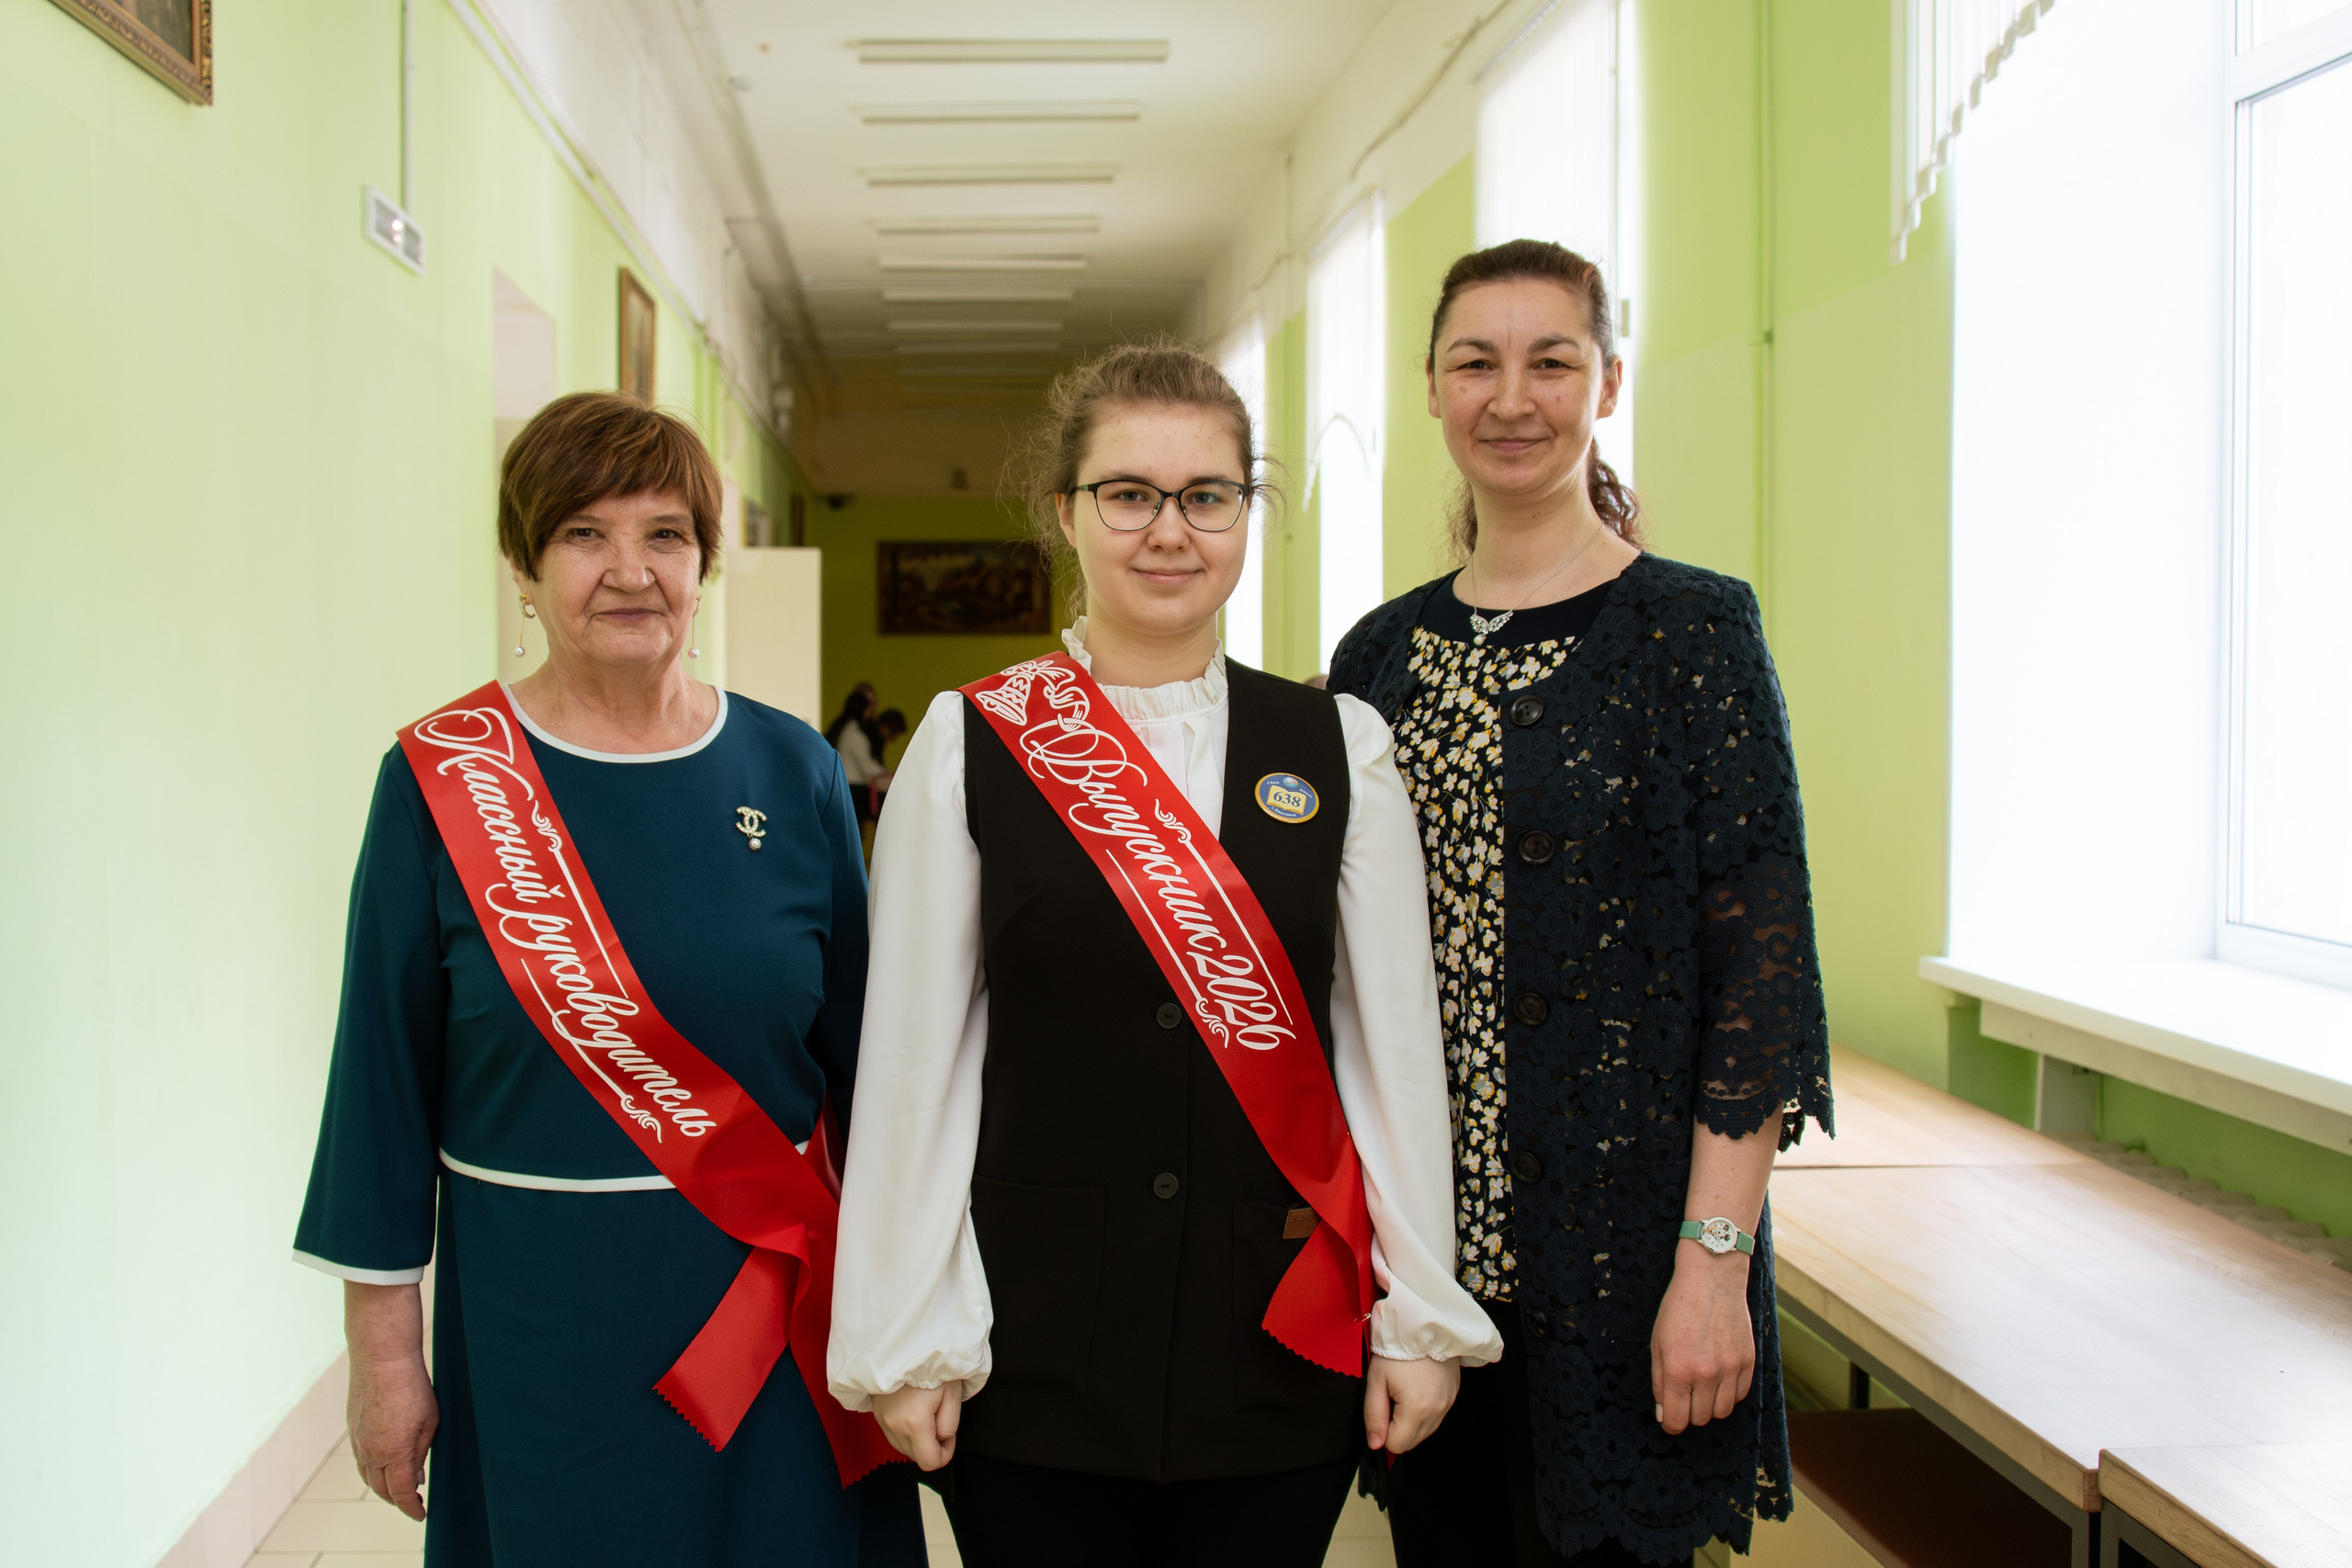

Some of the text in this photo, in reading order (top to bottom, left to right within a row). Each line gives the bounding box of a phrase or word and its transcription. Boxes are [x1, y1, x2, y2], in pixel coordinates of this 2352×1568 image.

[414, 706, 717, 1137] Классный руководитель
[1019, 719, 1296, 1051] Выпускник 2026
[1273, 791, 1301, 807] 638
